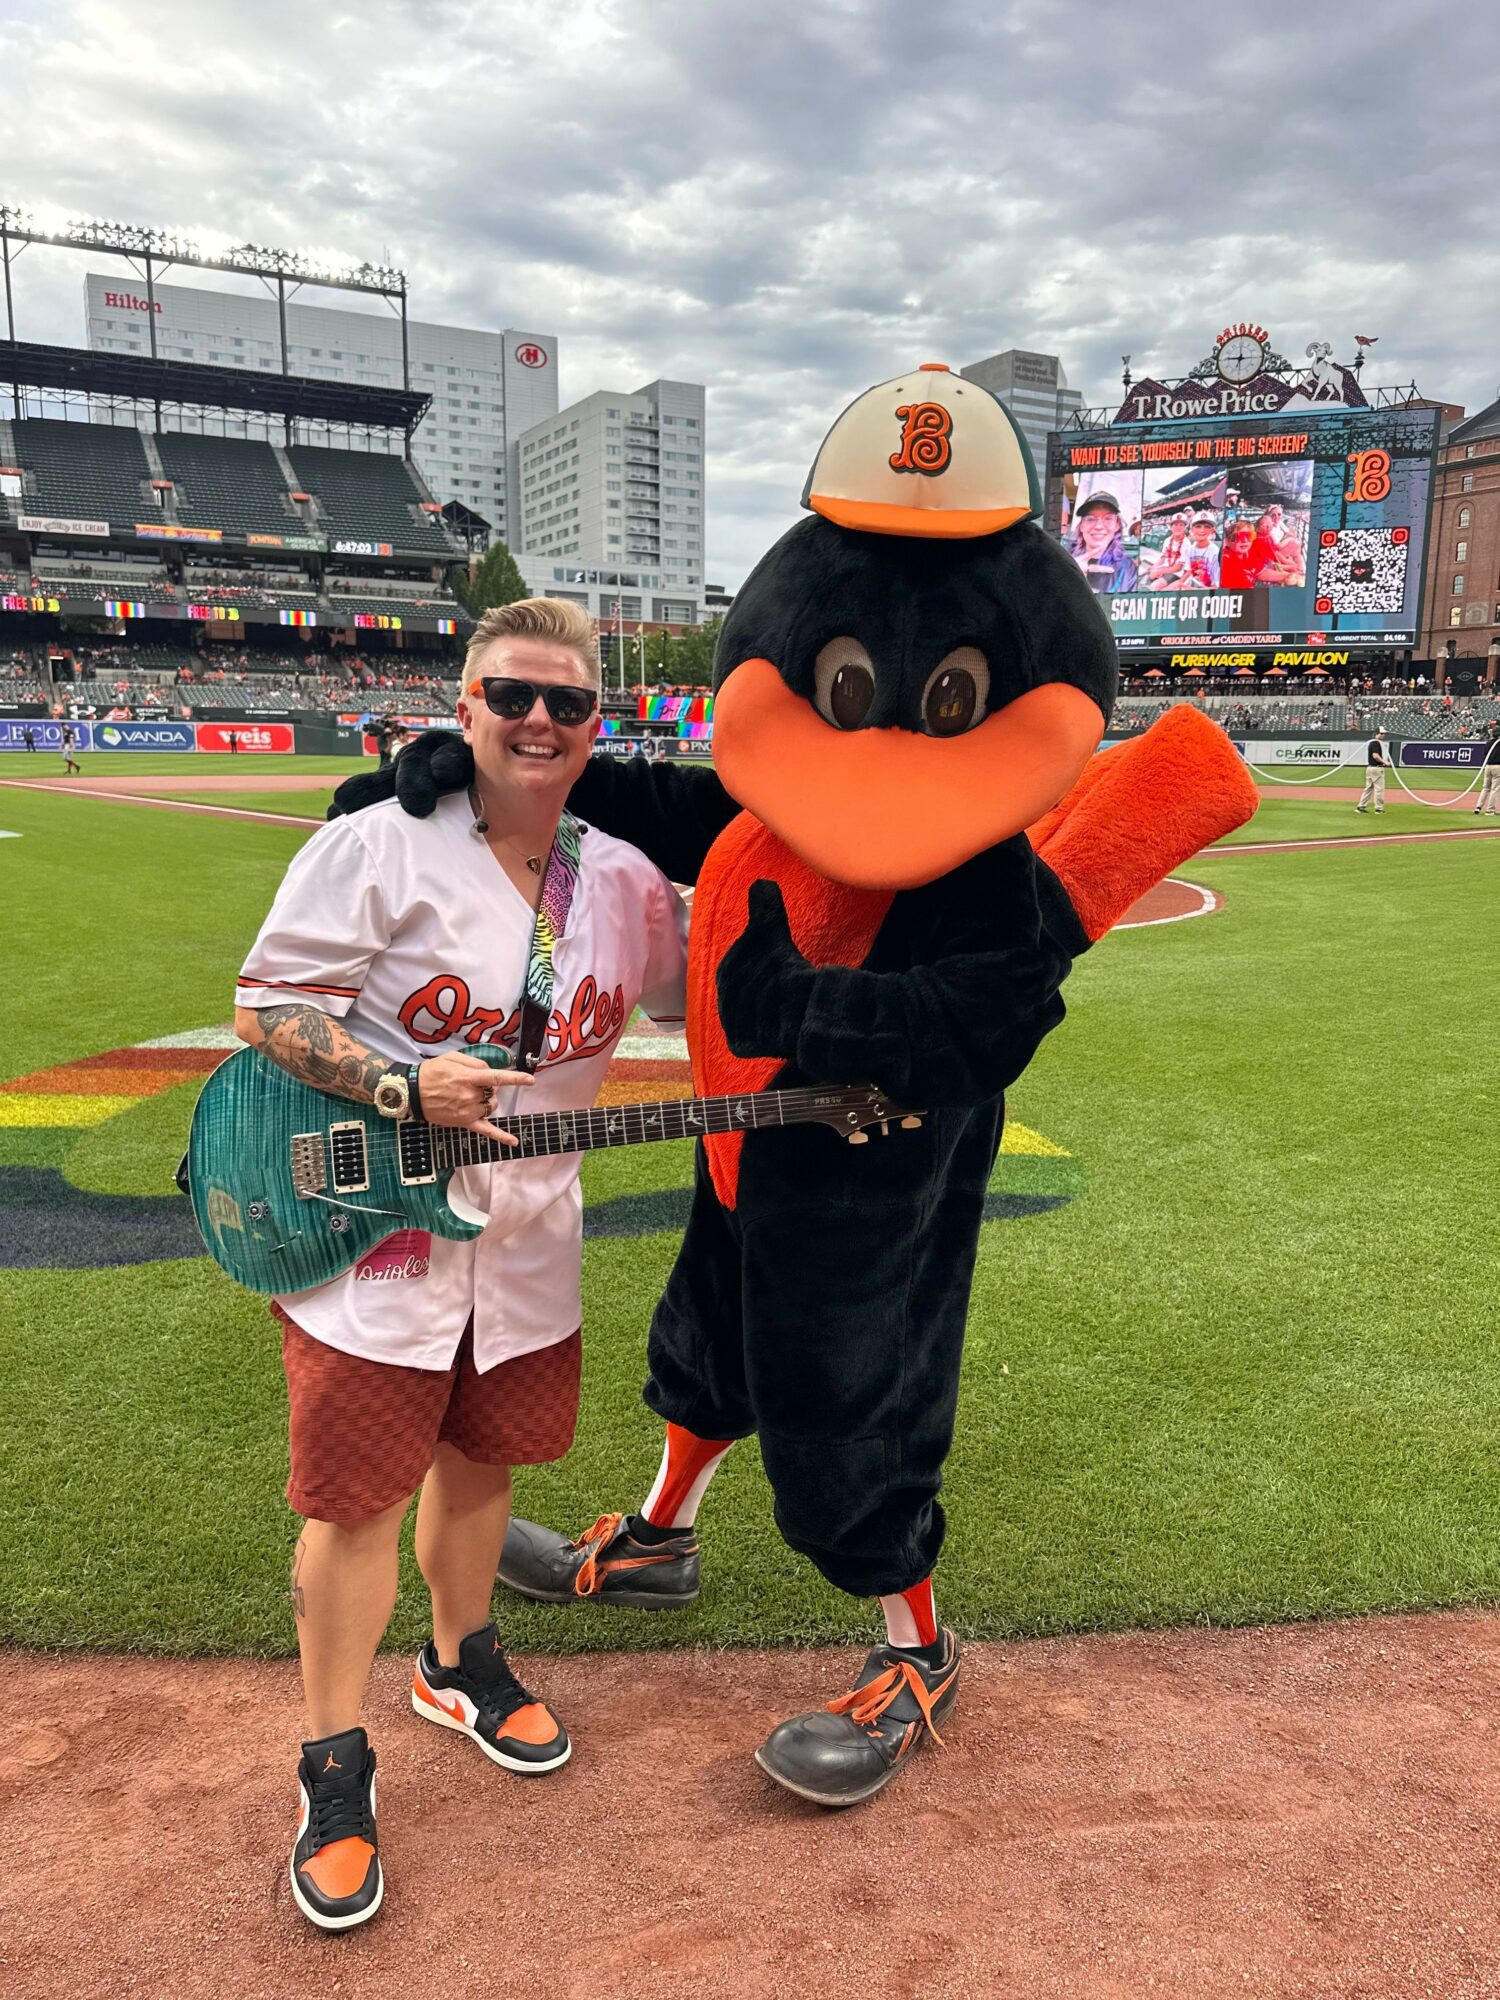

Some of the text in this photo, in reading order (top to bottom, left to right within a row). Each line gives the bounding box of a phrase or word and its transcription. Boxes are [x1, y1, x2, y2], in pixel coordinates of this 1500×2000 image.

[105, 293, 162, 313] Hilton
[889, 402, 953, 476] B
[1071, 434, 1308, 466] WANT TO SEE YOURSELF ON THE BIG SCREEN?
[1344, 448, 1392, 502] B
[22, 520, 42, 529] ENJOY
[72, 523, 82, 531] ICE
[84, 524, 105, 533] CREAM
[2, 596, 27, 611] FREE
[31, 597, 44, 611] TO
[1111, 595, 1243, 621] SCAN THE QR CODE!
[187, 605, 210, 619] FREE
[213, 607, 225, 620] TO
[354, 614, 376, 628] FREE
[377, 615, 389, 629] TO
[1160, 636, 1190, 645] ORIOLE
[1191, 636, 1211, 645] PARK
[1220, 635, 1254, 644] CAMDEN
[1255, 635, 1282, 643] YARDS
[1170, 652, 1349, 667] PUREWAGER PAVILION
[121, 731, 187, 743] VANDA
[218, 727, 272, 744] weis
[1295, 749, 1341, 759] RANKIN
[1422, 750, 1457, 759] TRUIST
[357, 1254, 430, 1280] Orioles
